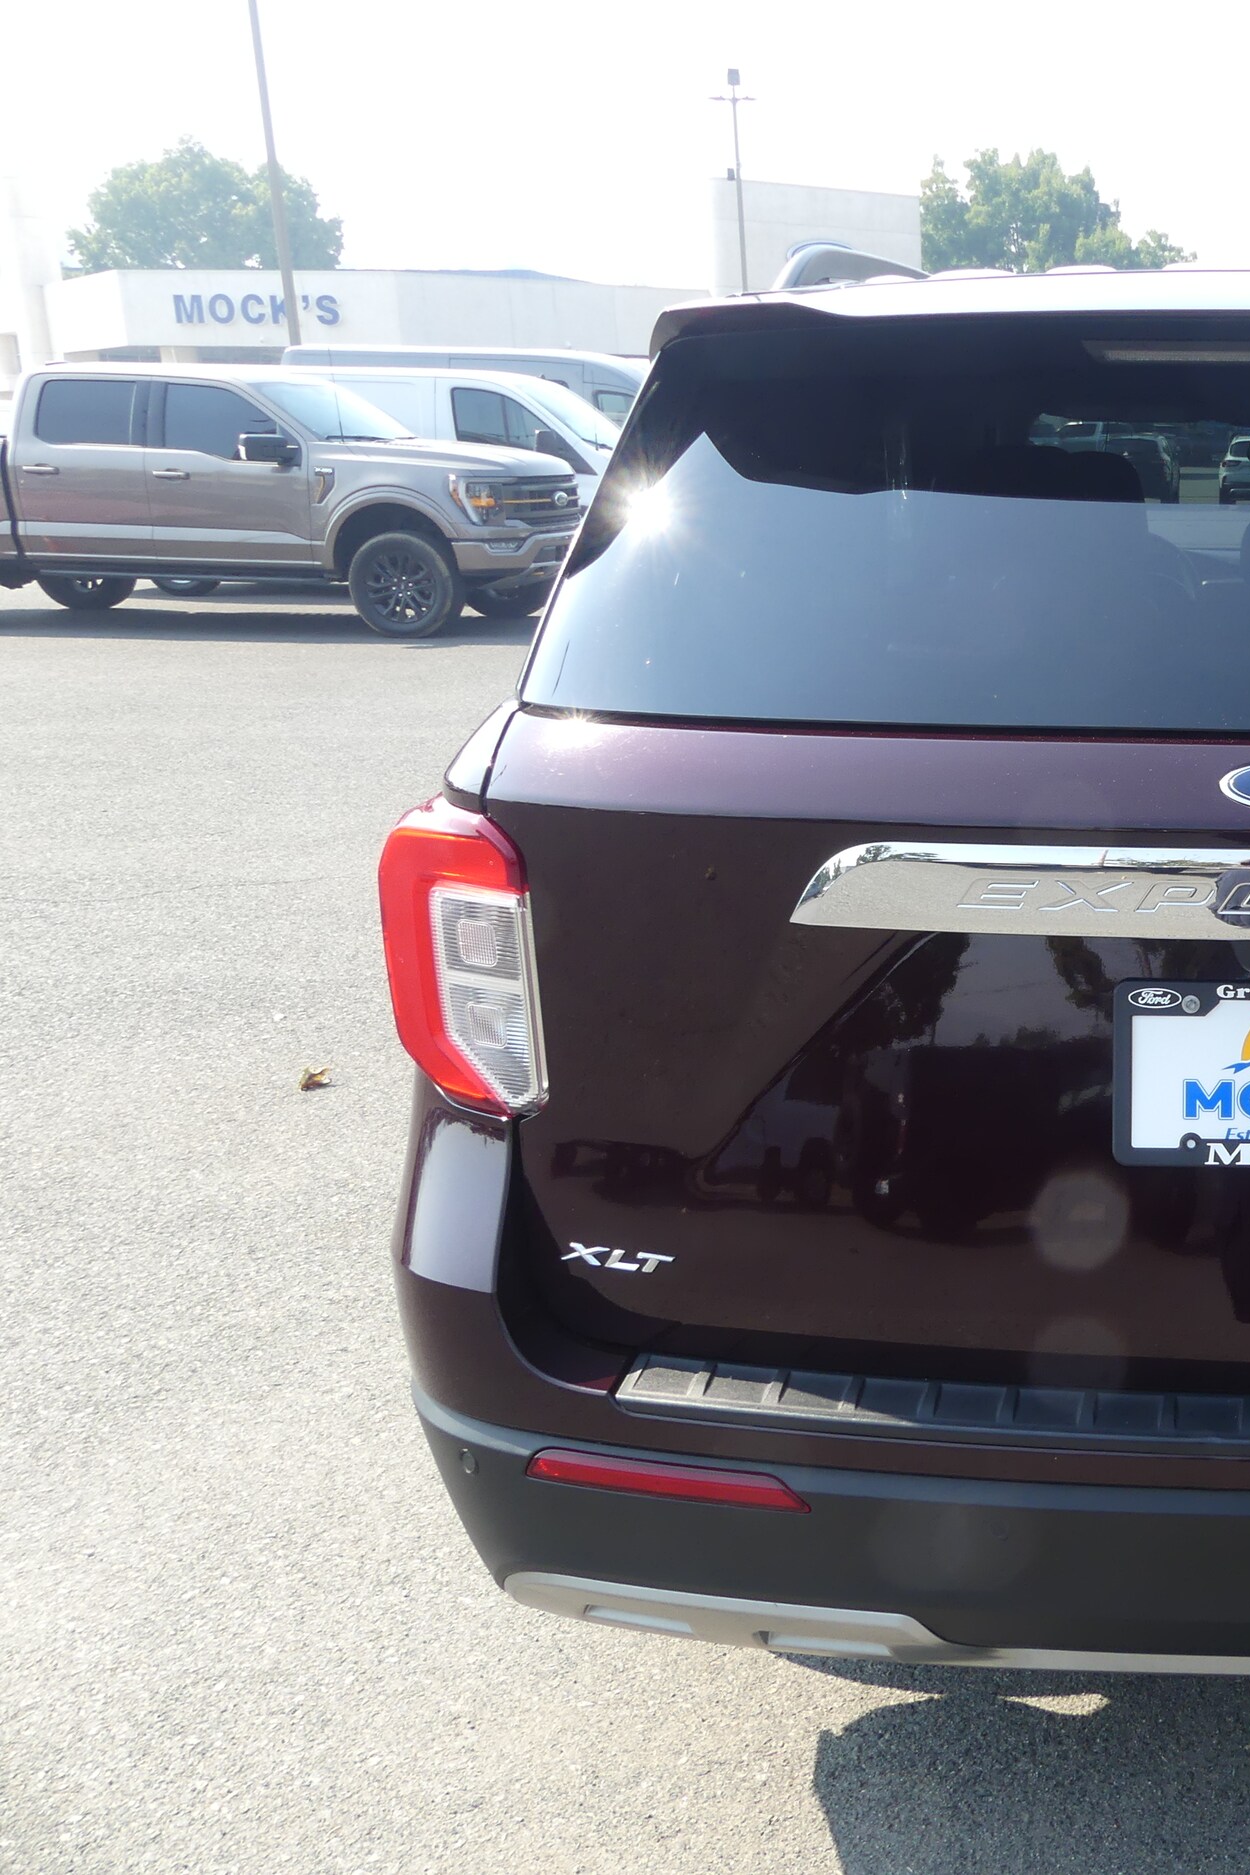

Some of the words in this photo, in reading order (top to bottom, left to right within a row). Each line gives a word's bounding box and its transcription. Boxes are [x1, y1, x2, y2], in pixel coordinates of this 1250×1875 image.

[172, 293, 341, 326] MOCK'S
[1138, 990, 1171, 1005] Ford
[560, 1241, 676, 1273] XLT
